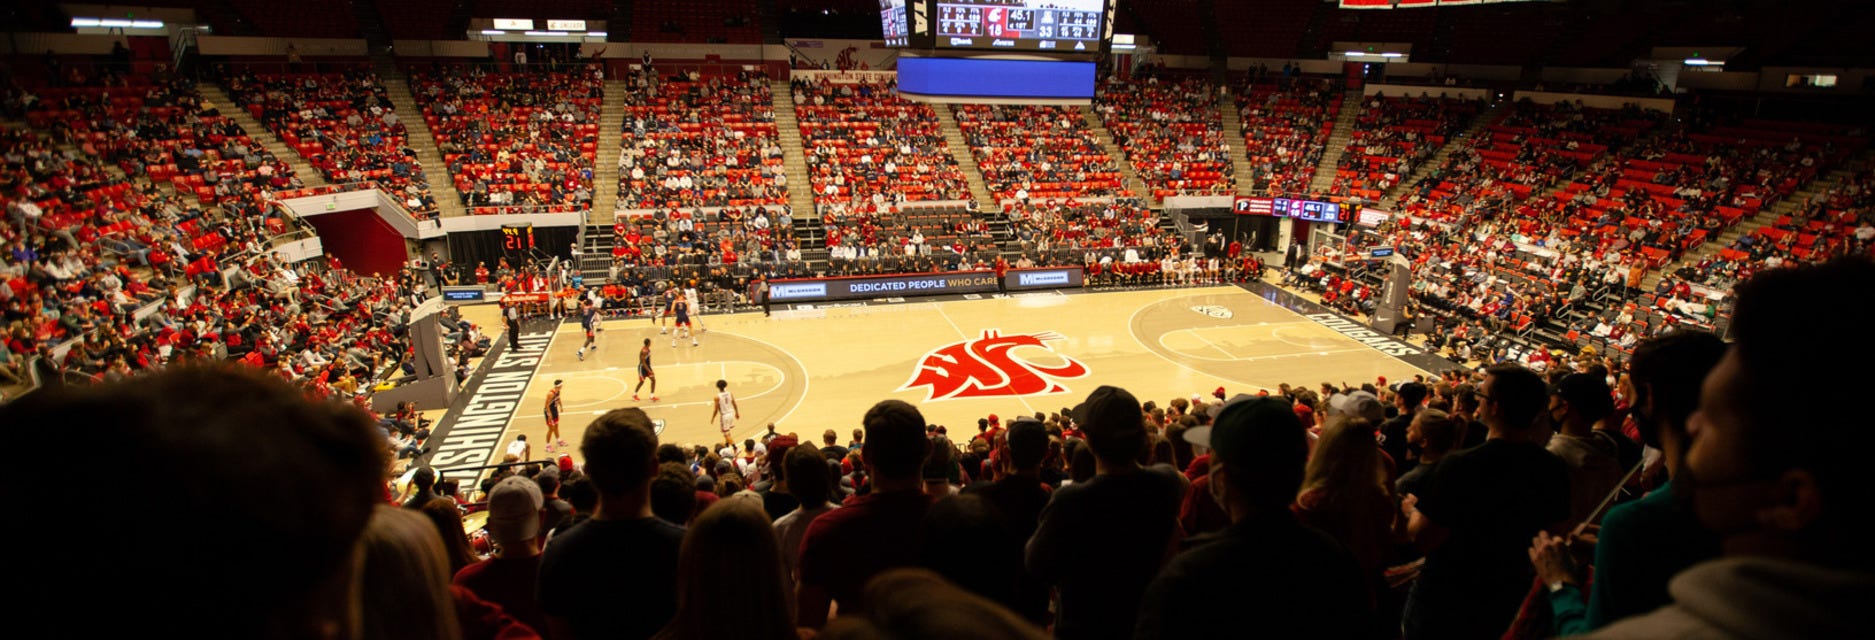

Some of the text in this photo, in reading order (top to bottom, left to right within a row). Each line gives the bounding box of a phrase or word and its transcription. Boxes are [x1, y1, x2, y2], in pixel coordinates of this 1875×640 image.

[1010, 9, 1030, 21] 45.1
[989, 24, 1002, 36] 18
[1039, 26, 1053, 38] 33
[505, 235, 522, 249] 21
[850, 281, 906, 293] DEDICATED
[908, 279, 946, 289] PEOPLE
[947, 278, 972, 288] WHO
[1304, 312, 1422, 356] COUGARS
[429, 370, 533, 492] ASHINGTON
